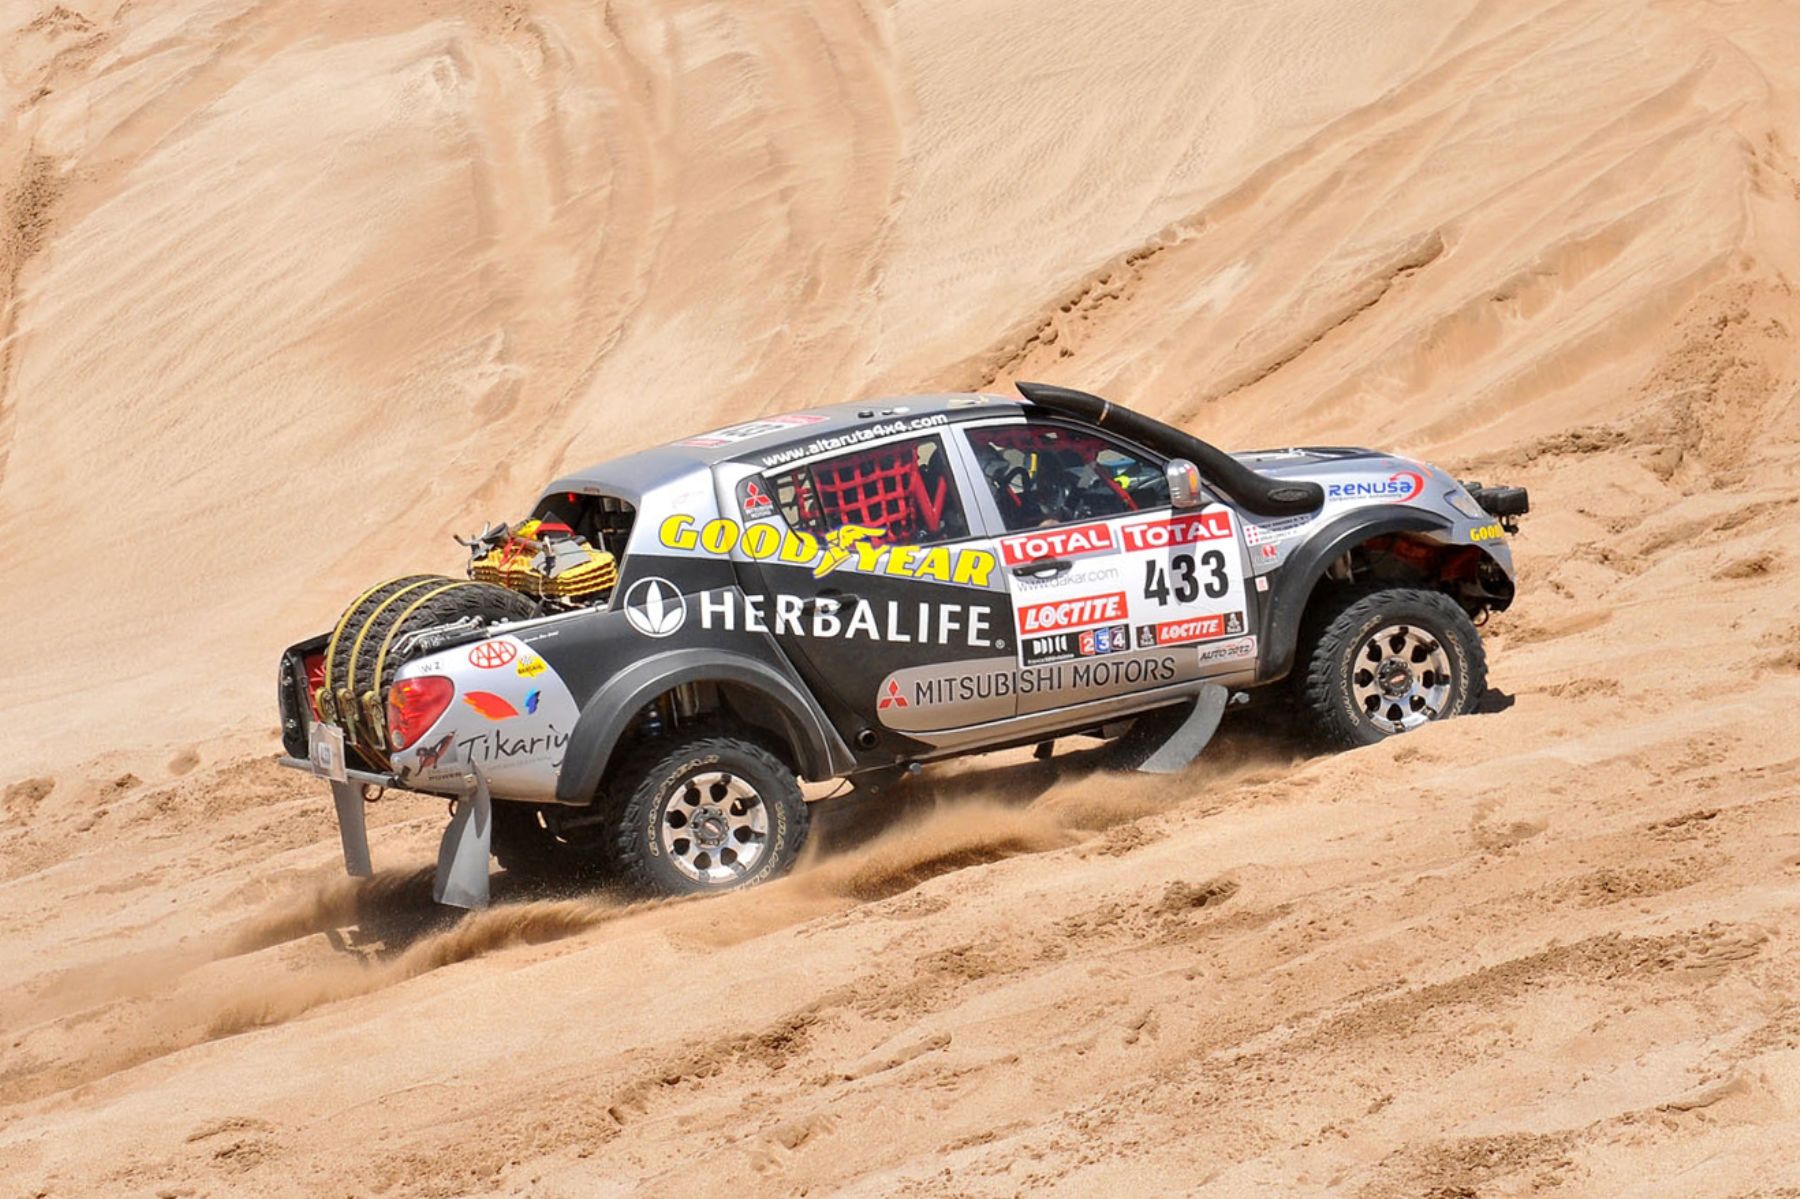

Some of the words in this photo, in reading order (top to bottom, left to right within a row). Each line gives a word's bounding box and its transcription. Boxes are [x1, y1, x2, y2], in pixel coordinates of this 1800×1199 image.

[762, 412, 948, 467] www.altaruta4x4.com
[659, 514, 996, 588] GOODYEAR
[1005, 529, 1111, 558] TOTAL
[1124, 517, 1231, 547] TOTAL
[1144, 549, 1230, 606] 433
[701, 590, 992, 647] HERBALIFE
[1024, 595, 1121, 630] LOCTITE
[1160, 619, 1219, 640] LOCTITE
[915, 668, 1062, 706] MITSUBISHI
[1072, 657, 1176, 689] MOTORS
